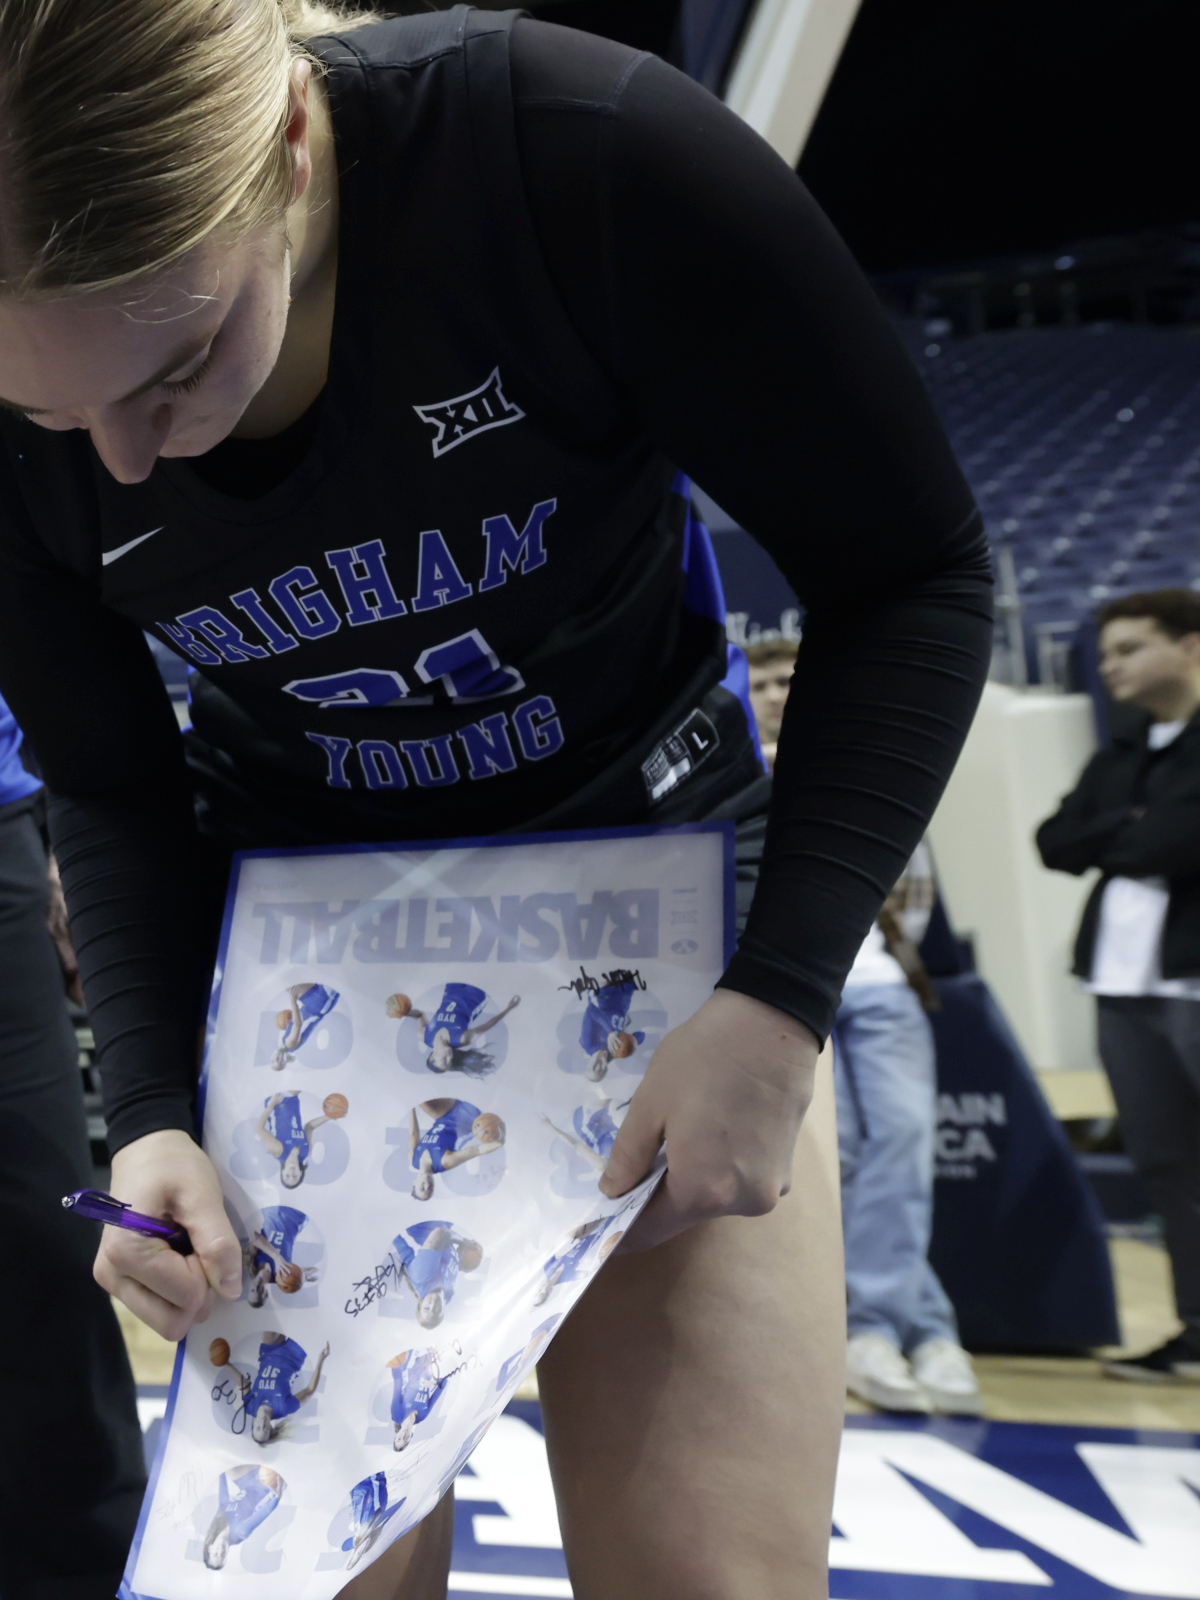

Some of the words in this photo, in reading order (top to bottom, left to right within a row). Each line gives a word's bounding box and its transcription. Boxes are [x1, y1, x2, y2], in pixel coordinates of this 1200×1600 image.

[155, 497, 557, 665] BRIGHAM
[305, 694, 565, 790] YOUNG
[252, 888, 660, 966] BASKETBALL
[269, 1230, 284, 1245] 21
[258, 1379, 276, 1390] BYU
[261, 1365, 281, 1378] 30
